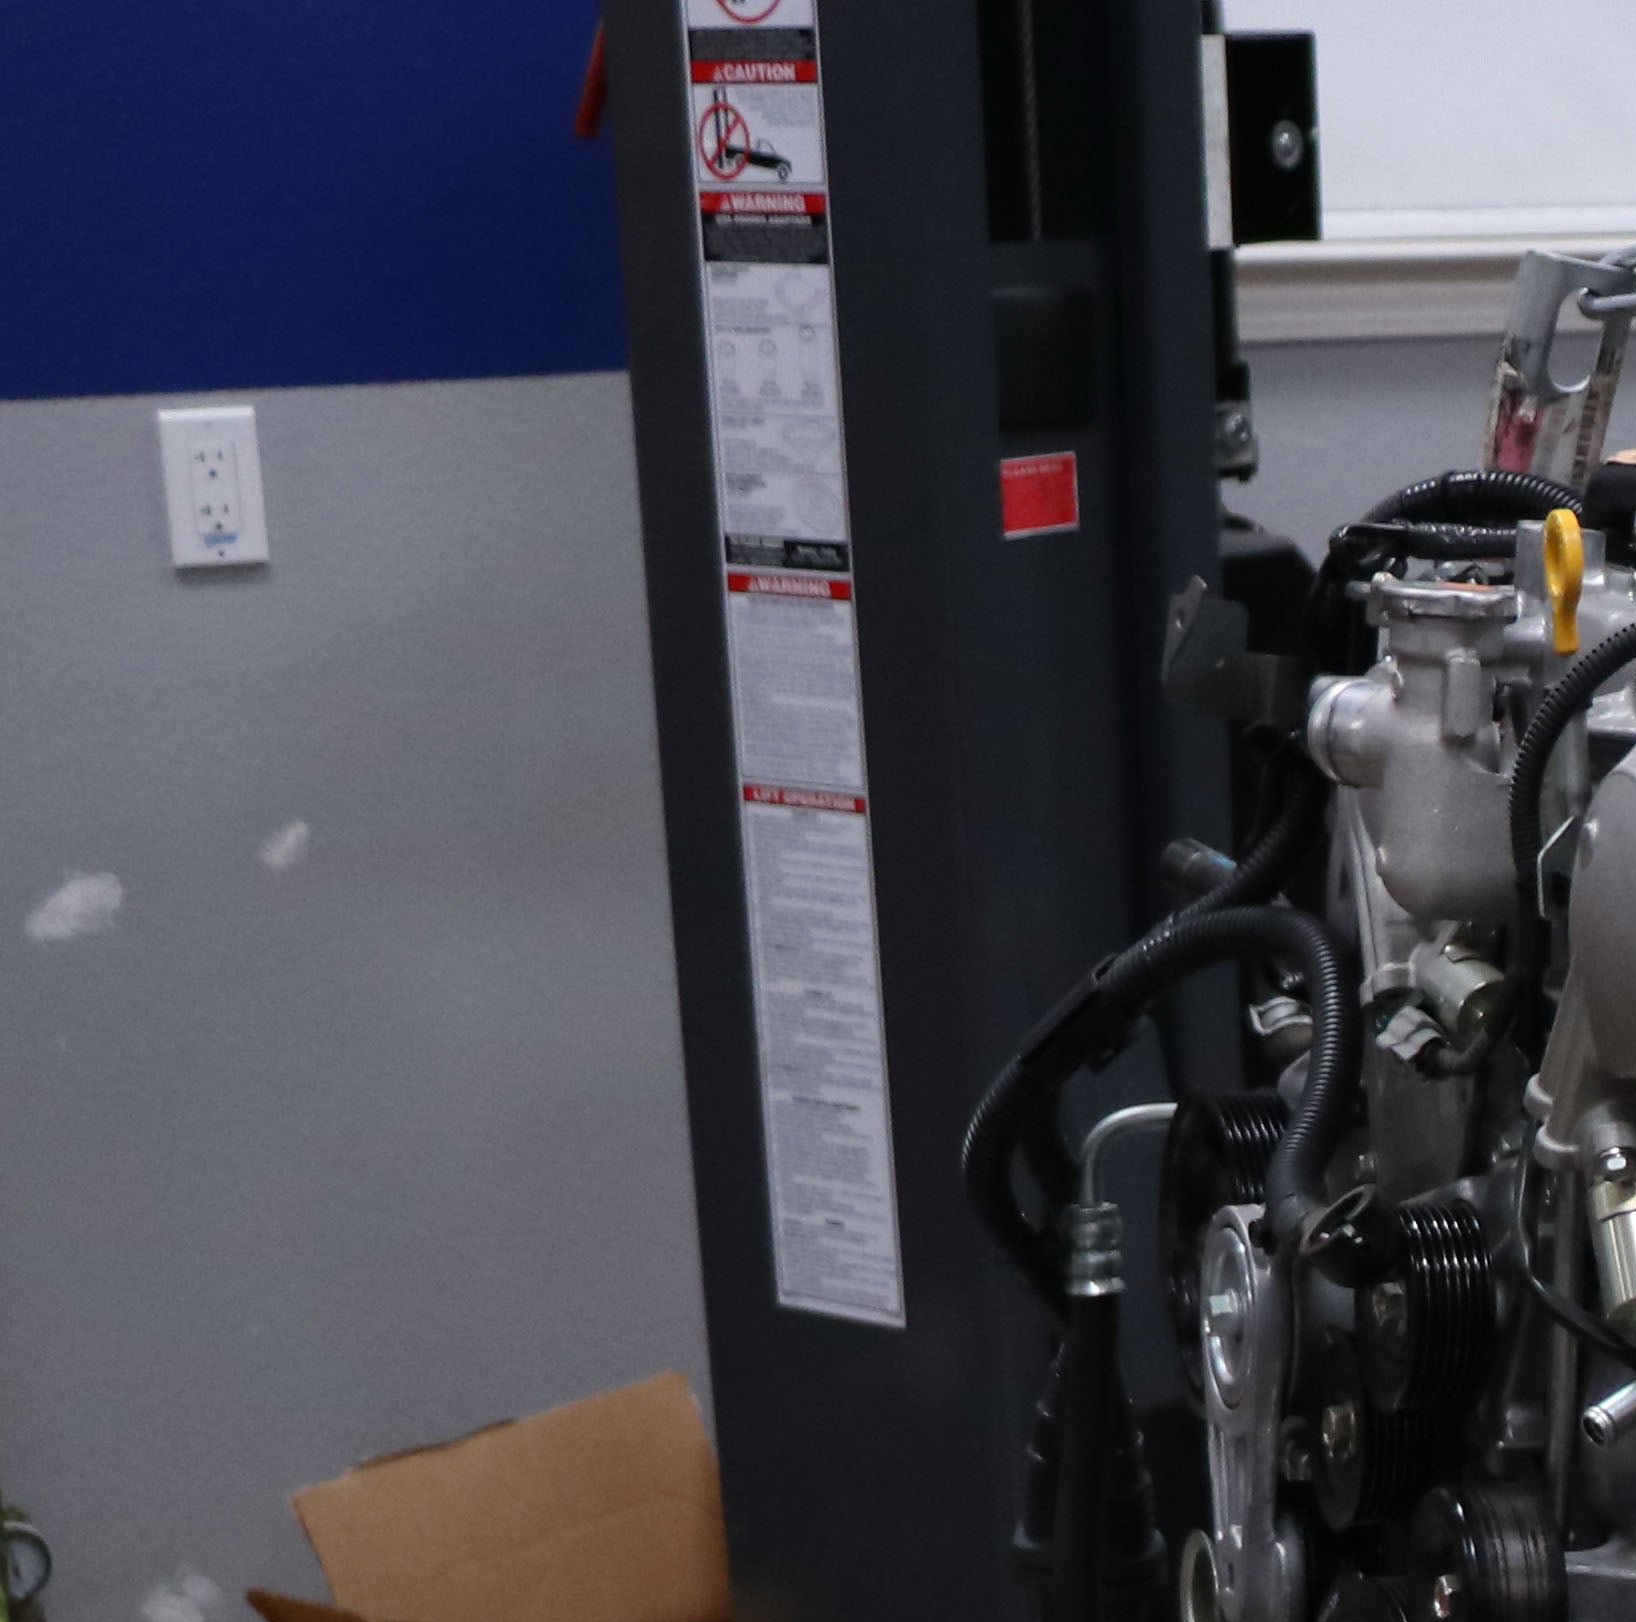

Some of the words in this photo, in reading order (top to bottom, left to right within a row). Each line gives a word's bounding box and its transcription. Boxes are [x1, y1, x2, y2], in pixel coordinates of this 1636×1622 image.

[722, 62, 796, 82] CAUTION
[730, 193, 806, 213] WARNING
[757, 576, 832, 597] WARNING
